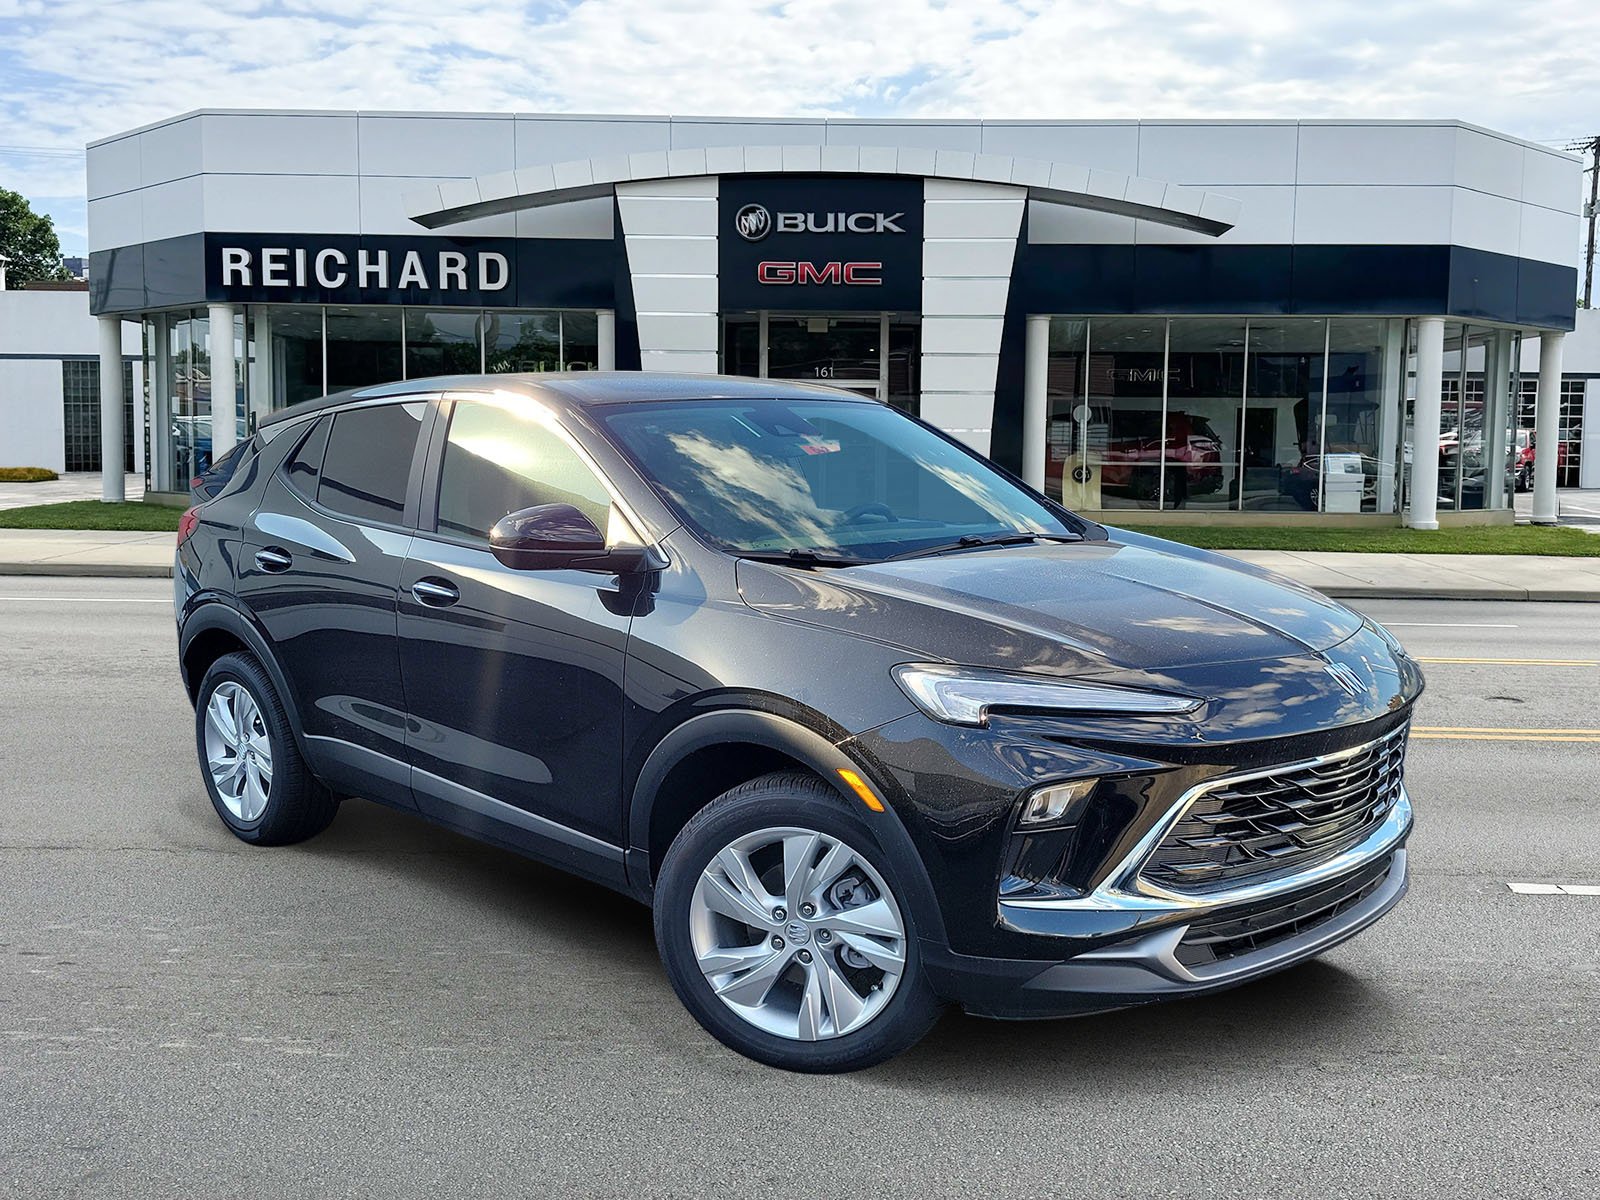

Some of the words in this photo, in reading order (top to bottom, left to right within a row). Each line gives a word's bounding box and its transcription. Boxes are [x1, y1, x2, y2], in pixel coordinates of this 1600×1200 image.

[777, 212, 906, 233] BUICK
[221, 247, 510, 291] REICHARD
[757, 260, 883, 285] GMC
[814, 366, 834, 378] 161
[1106, 368, 1182, 382] GMC
